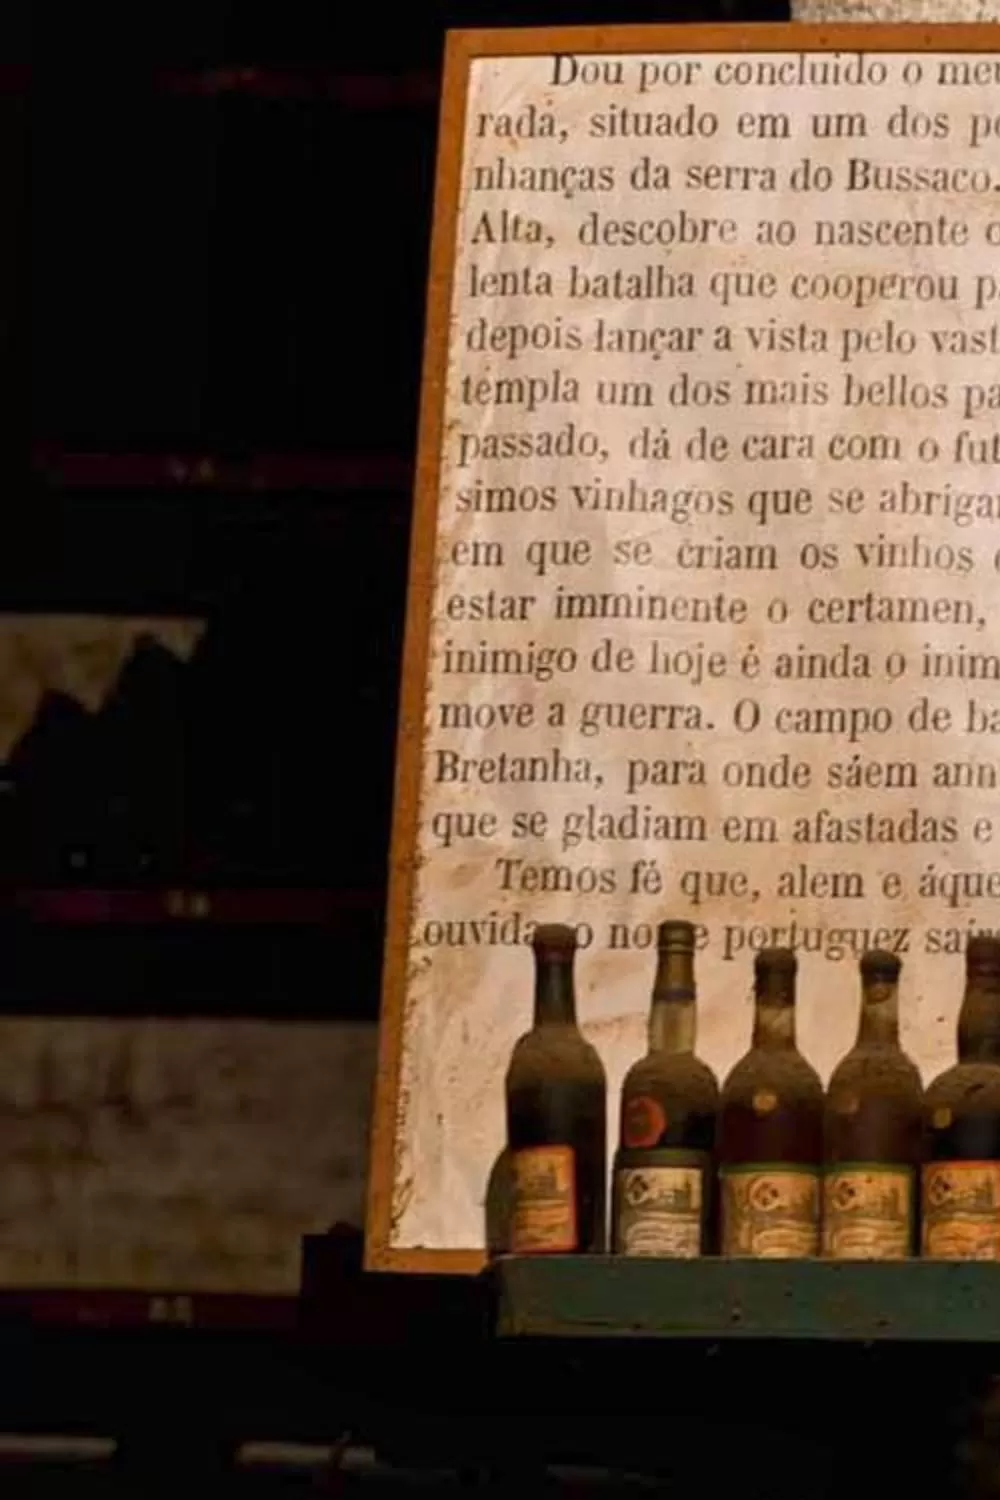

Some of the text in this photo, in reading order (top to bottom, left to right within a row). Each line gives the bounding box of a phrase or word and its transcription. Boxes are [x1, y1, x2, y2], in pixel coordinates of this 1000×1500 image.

[549, 53, 627, 85] Dou
[638, 62, 702, 95] por
[713, 53, 889, 85] concluido
[587, 106, 721, 138] situado
[885, 106, 951, 138] dos
[473, 160, 617, 199] nhanças
[683, 169, 778, 192] serra
[470, 213, 558, 252] Alta,
[576, 213, 740, 245] descobre
[814, 216, 971, 246] nascente
[468, 266, 555, 298] lenta
[567, 266, 696, 299] batalha
[708, 276, 779, 309] que
[789, 276, 959, 309] cooperou
[464, 320, 585, 362] depois
[593, 320, 705, 359] lançar
[743, 323, 830, 353] vista
[840, 321, 919, 363] pelo
[595, 382, 656, 406] um
[667, 374, 733, 406] dos
[743, 377, 830, 407] mais
[842, 375, 951, 407] bellos
[457, 427, 611, 470] passado,
[684, 428, 731, 460] de
[740, 437, 815, 461] cara
[827, 437, 903, 461] com
[455, 484, 559, 514] simos
[745, 491, 814, 525] que
[450, 543, 506, 567] em
[524, 544, 593, 578] que
[852, 537, 976, 571] vinhos
[446, 592, 537, 622] estar
[553, 592, 749, 624] imminente
[805, 594, 988, 632] certamen,
[442, 645, 579, 686] inimigo
[647, 644, 729, 687] hoje
[773, 645, 874, 678] ainda
[438, 705, 535, 730] move
[578, 707, 716, 742] guerra.
[732, 699, 762, 732] O
[773, 708, 894, 744] campo
[434, 751, 606, 793] Bretanha,
[625, 762, 709, 797] para
[721, 754, 813, 788] onde
[826, 755, 920, 789] sáem
[430, 815, 498, 850] que
[510, 816, 549, 840] se
[561, 807, 710, 852] gladiam
[791, 810, 960, 845] afastadas
[499, 861, 619, 895] Temos
[627, 862, 665, 896] fé
[678, 872, 762, 907] que,
[776, 864, 867, 898] alem
[723, 917, 911, 960] portuguez
